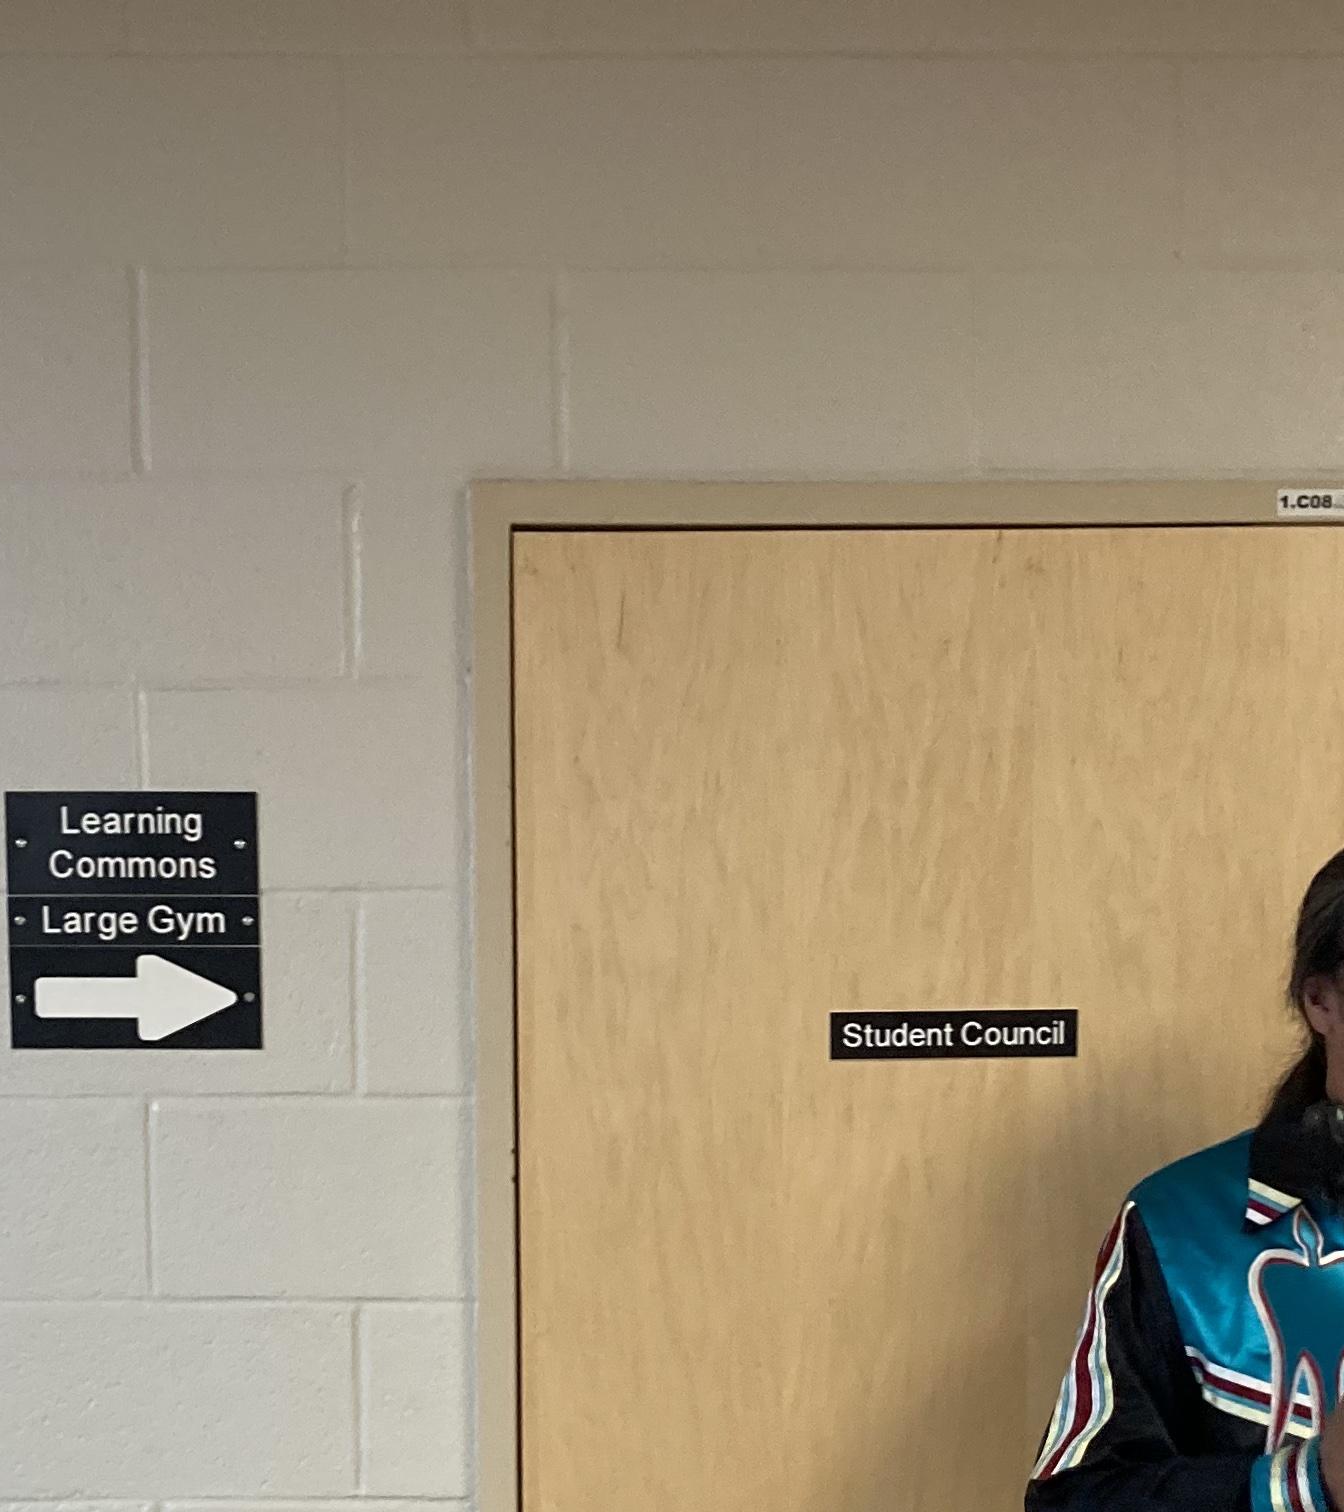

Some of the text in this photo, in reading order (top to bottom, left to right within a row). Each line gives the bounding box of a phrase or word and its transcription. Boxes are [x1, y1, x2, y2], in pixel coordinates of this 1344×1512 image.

[1280, 494, 1333, 509] 1.C08
[60, 806, 203, 842] Learning
[48, 849, 218, 879] Commons
[42, 905, 226, 940] Large Gym
[842, 1020, 1065, 1047] Student Council
